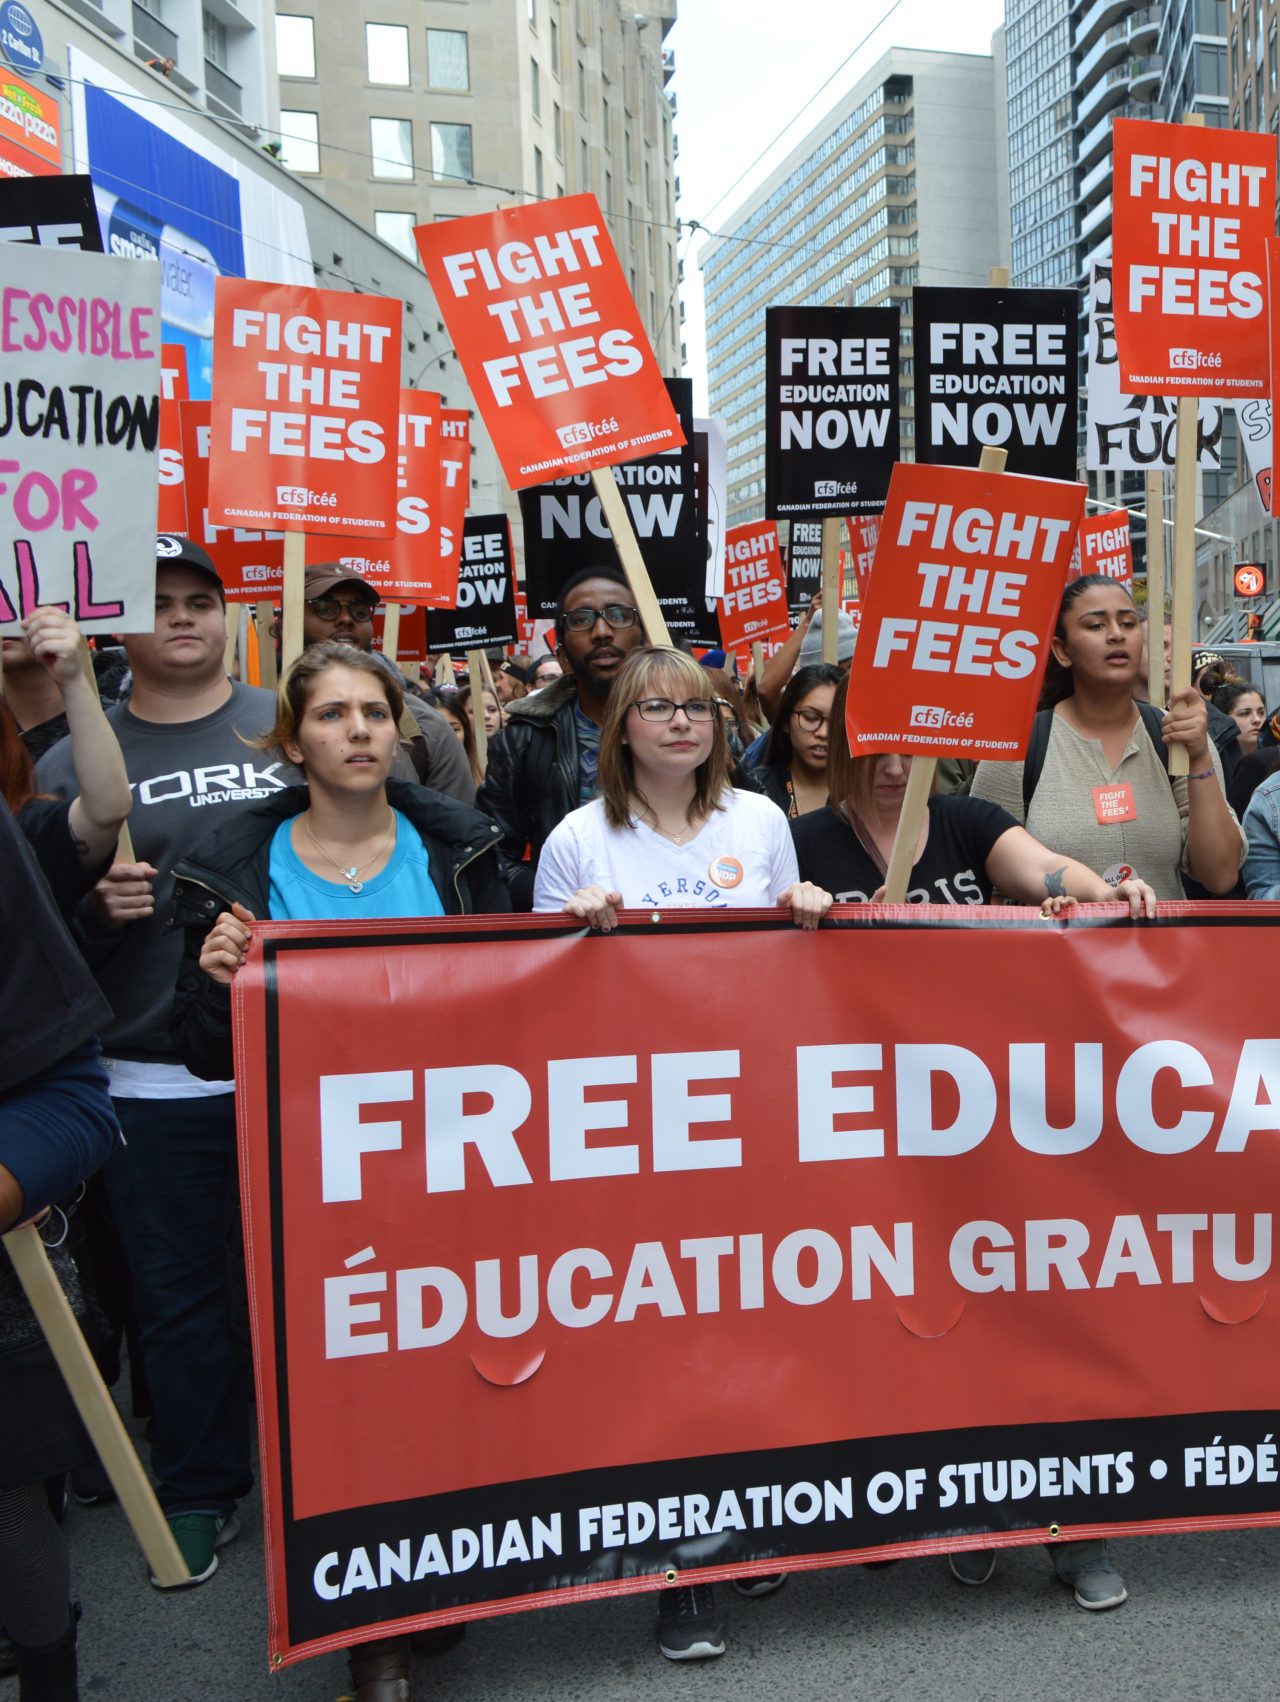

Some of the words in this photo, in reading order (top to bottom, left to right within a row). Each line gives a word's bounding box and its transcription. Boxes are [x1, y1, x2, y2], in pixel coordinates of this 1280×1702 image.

[0, 95, 24, 128] zza
[1129, 154, 1267, 208] FIGHT
[1151, 212, 1241, 260] THE
[442, 225, 602, 298] FIGHT
[1129, 264, 1263, 319] FEES
[2, 287, 155, 360] ESSIBLE
[487, 282, 601, 344] THE
[233, 308, 391, 363] FIGHT
[930, 323, 1066, 366] FREE
[482, 329, 643, 408] FEES
[780, 338, 890, 376] FREE
[258, 362, 360, 409] THE
[779, 384, 890, 403] EDUCATION
[930, 375, 1065, 395] EDUCATION
[1129, 374, 1164, 384] CANADIAN
[1165, 376, 1213, 386] FEDERATION
[1215, 378, 1225, 386] OF
[1226, 379, 1264, 388] STUDENTS
[0, 379, 159, 452] UCATION
[780, 408, 891, 450] NOW
[931, 403, 1067, 446] NOW
[231, 407, 386, 464] FEES
[520, 458, 563, 474] CANADIAN
[564, 444, 616, 464] FEDERATION
[618, 441, 628, 449] OF
[631, 429, 672, 446] STUDENTS
[224, 508, 270, 519] CANADIAN
[273, 511, 326, 523] FEDERATION
[329, 516, 341, 524] OF
[342, 517, 386, 528] STUDENTS
[777, 504, 810, 512] CANADIAN
[812, 502, 849, 510] FEDERATION
[460, 533, 504, 561] EE
[793, 523, 822, 542] FREE
[793, 546, 821, 555] EDUCATION
[896, 500, 1071, 563] FIGHT
[1085, 524, 1130, 557] FIGHT
[394, 581, 432, 589] STUDENTS
[459, 562, 505, 578] ATION
[728, 559, 770, 587] THE
[792, 558, 821, 578] NOW
[1096, 554, 1127, 578] THE
[456, 578, 507, 608] OW
[657, 597, 688, 605] UDENTS
[723, 579, 782, 617] FEES
[917, 563, 1027, 617] THE
[872, 617, 1040, 679] FEES
[857, 733, 900, 743] CANADIAN
[902, 734, 958, 746] FEDERATION
[960, 738, 973, 747] OF
[974, 739, 1019, 749] STUDENTS
[129, 762, 288, 805] ORK
[1100, 790, 1126, 801] FIGHT
[1101, 800, 1118, 809] THE
[1103, 806, 1129, 817] FEES!
[642, 877, 728, 908] YERSO
[320, 1049, 742, 1203] FREE
[324, 1222, 914, 1359] ÉDUCATION
[313, 1512, 563, 1600] CANADIAN
[578, 1477, 853, 1550] FEDERATION
[867, 1467, 927, 1515] OF
[938, 1451, 1135, 1504] STUDENTS
